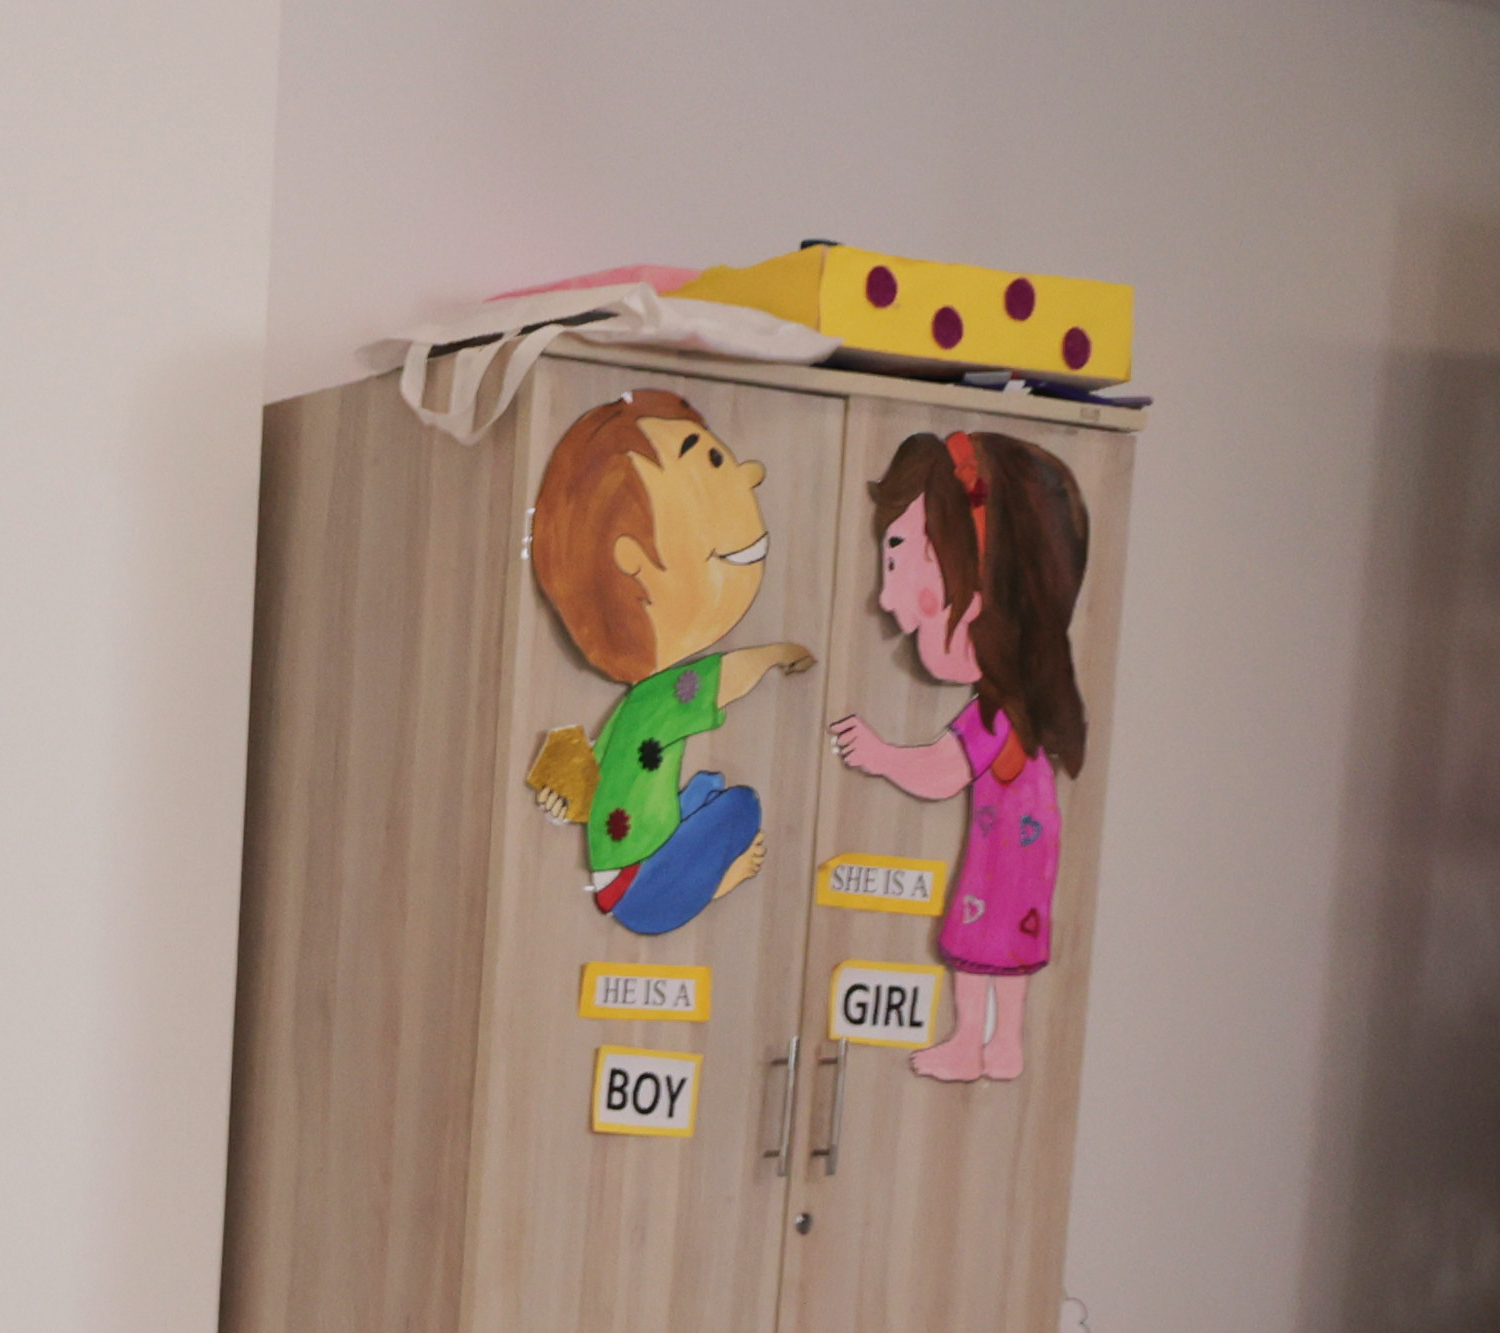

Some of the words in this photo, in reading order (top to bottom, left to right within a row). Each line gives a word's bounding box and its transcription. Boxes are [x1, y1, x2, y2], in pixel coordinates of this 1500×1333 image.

[831, 865, 877, 894] SHE
[882, 869, 906, 897] IS
[912, 872, 930, 899] A
[602, 976, 637, 1006] HE
[643, 979, 667, 1007] IS
[673, 983, 691, 1008] A
[843, 983, 924, 1029] GIRL
[606, 1068, 687, 1119] BOY
